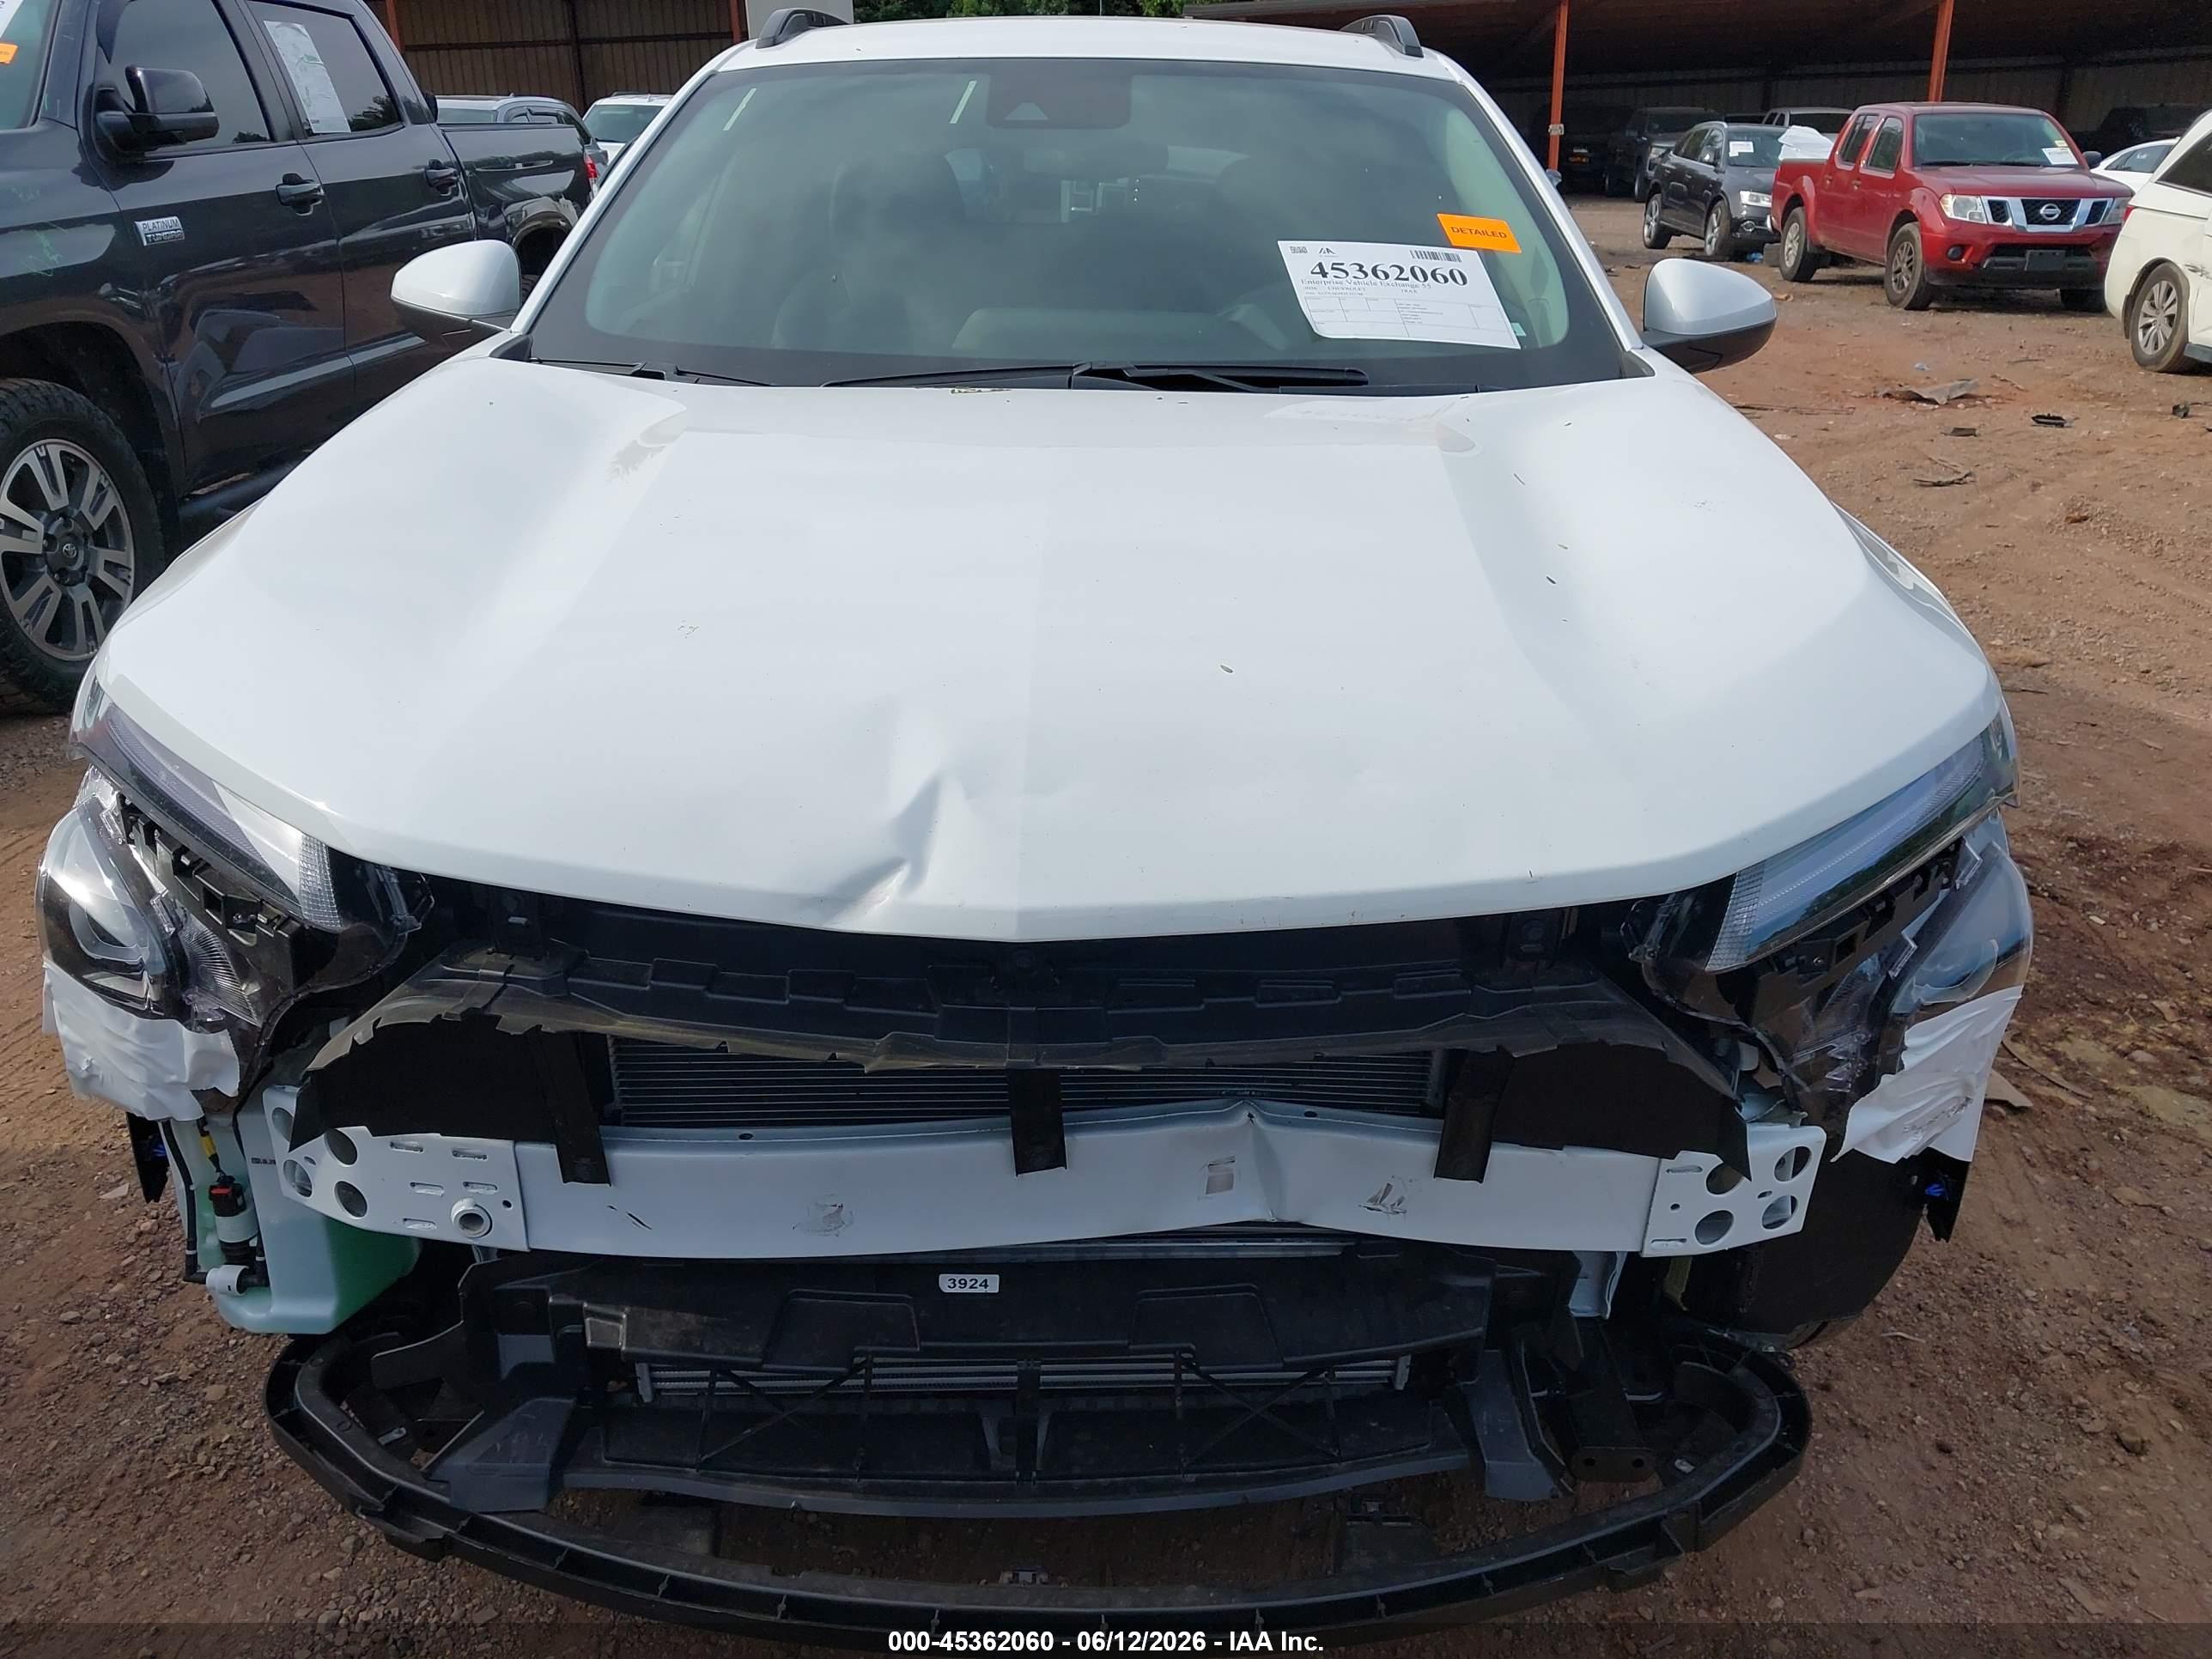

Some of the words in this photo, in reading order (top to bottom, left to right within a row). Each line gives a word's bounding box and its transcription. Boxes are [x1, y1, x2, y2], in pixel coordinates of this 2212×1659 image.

[142, 218, 179, 232] PLATINUM
[1450, 226, 1508, 239] DETAILED
[1310, 261, 1468, 286] 45362060
[1379, 281, 1420, 289] Exchange
[947, 1278, 989, 1290] 3924
